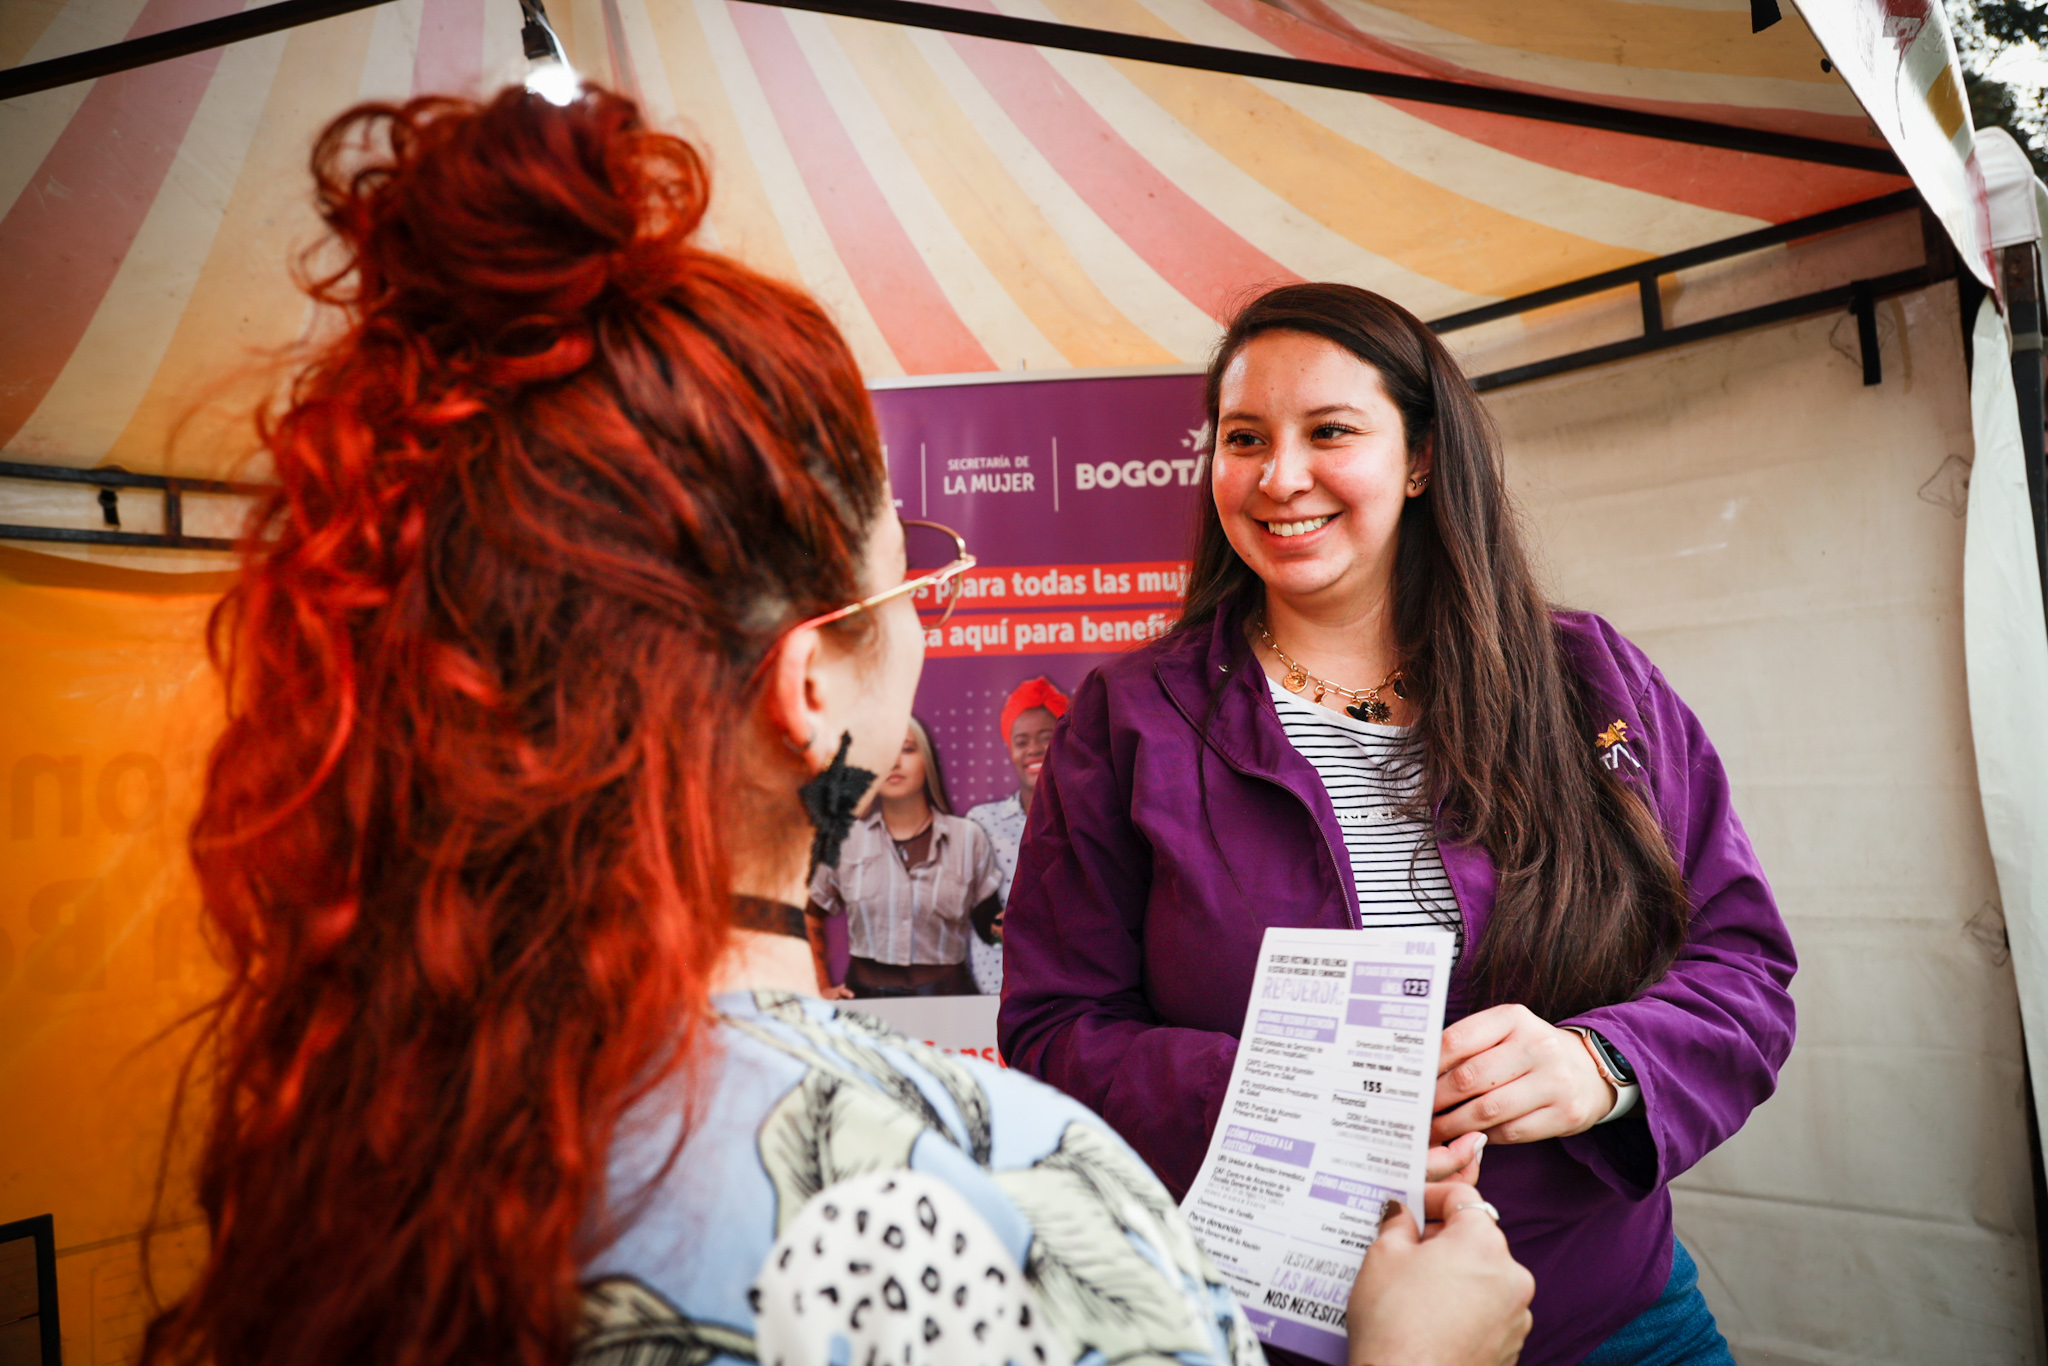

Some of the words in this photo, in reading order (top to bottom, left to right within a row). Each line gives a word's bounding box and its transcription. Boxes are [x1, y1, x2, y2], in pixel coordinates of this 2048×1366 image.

[947, 455, 1011, 471] SECRETARÍA
[1014, 456, 1030, 468] DE
[943, 475, 967, 495] LA
[971, 472, 1035, 493] MUJER
[1012, 569, 1087, 596] todas
[1093, 568, 1131, 594] las
[949, 618, 1009, 652] aquí
[1015, 623, 1075, 651] para
[1404, 980, 1429, 995] 123
[1363, 1080, 1382, 1093] 155
[1188, 1210, 1206, 1224] Para
[1270, 1266, 1302, 1292] LAS
[1264, 1289, 1290, 1310] NOS
